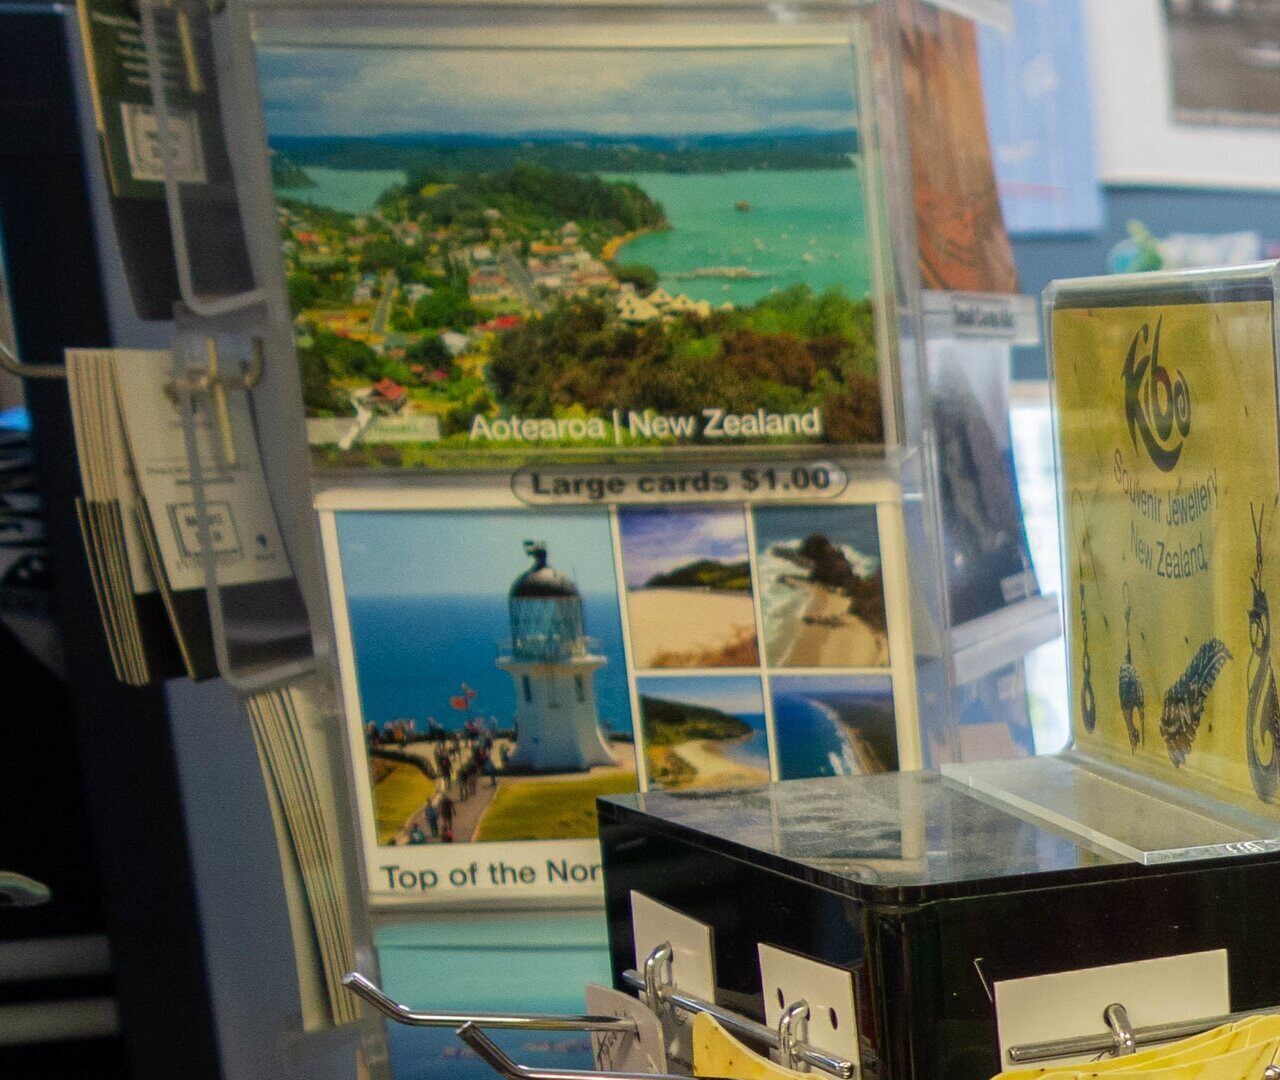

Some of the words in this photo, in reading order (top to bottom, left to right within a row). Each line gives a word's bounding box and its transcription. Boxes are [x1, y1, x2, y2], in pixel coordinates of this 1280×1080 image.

[469, 412, 606, 442] Aotearoa
[629, 408, 696, 437] New
[702, 406, 823, 437] Zealand
[531, 471, 625, 500] Large
[637, 469, 730, 494] cards
[740, 466, 831, 494] $1.00
[1113, 448, 1163, 524] Souvenir
[1165, 466, 1219, 527] Jewellery
[1130, 521, 1153, 572] New
[379, 863, 439, 892] Top
[449, 861, 478, 887] of
[489, 859, 537, 886] the
